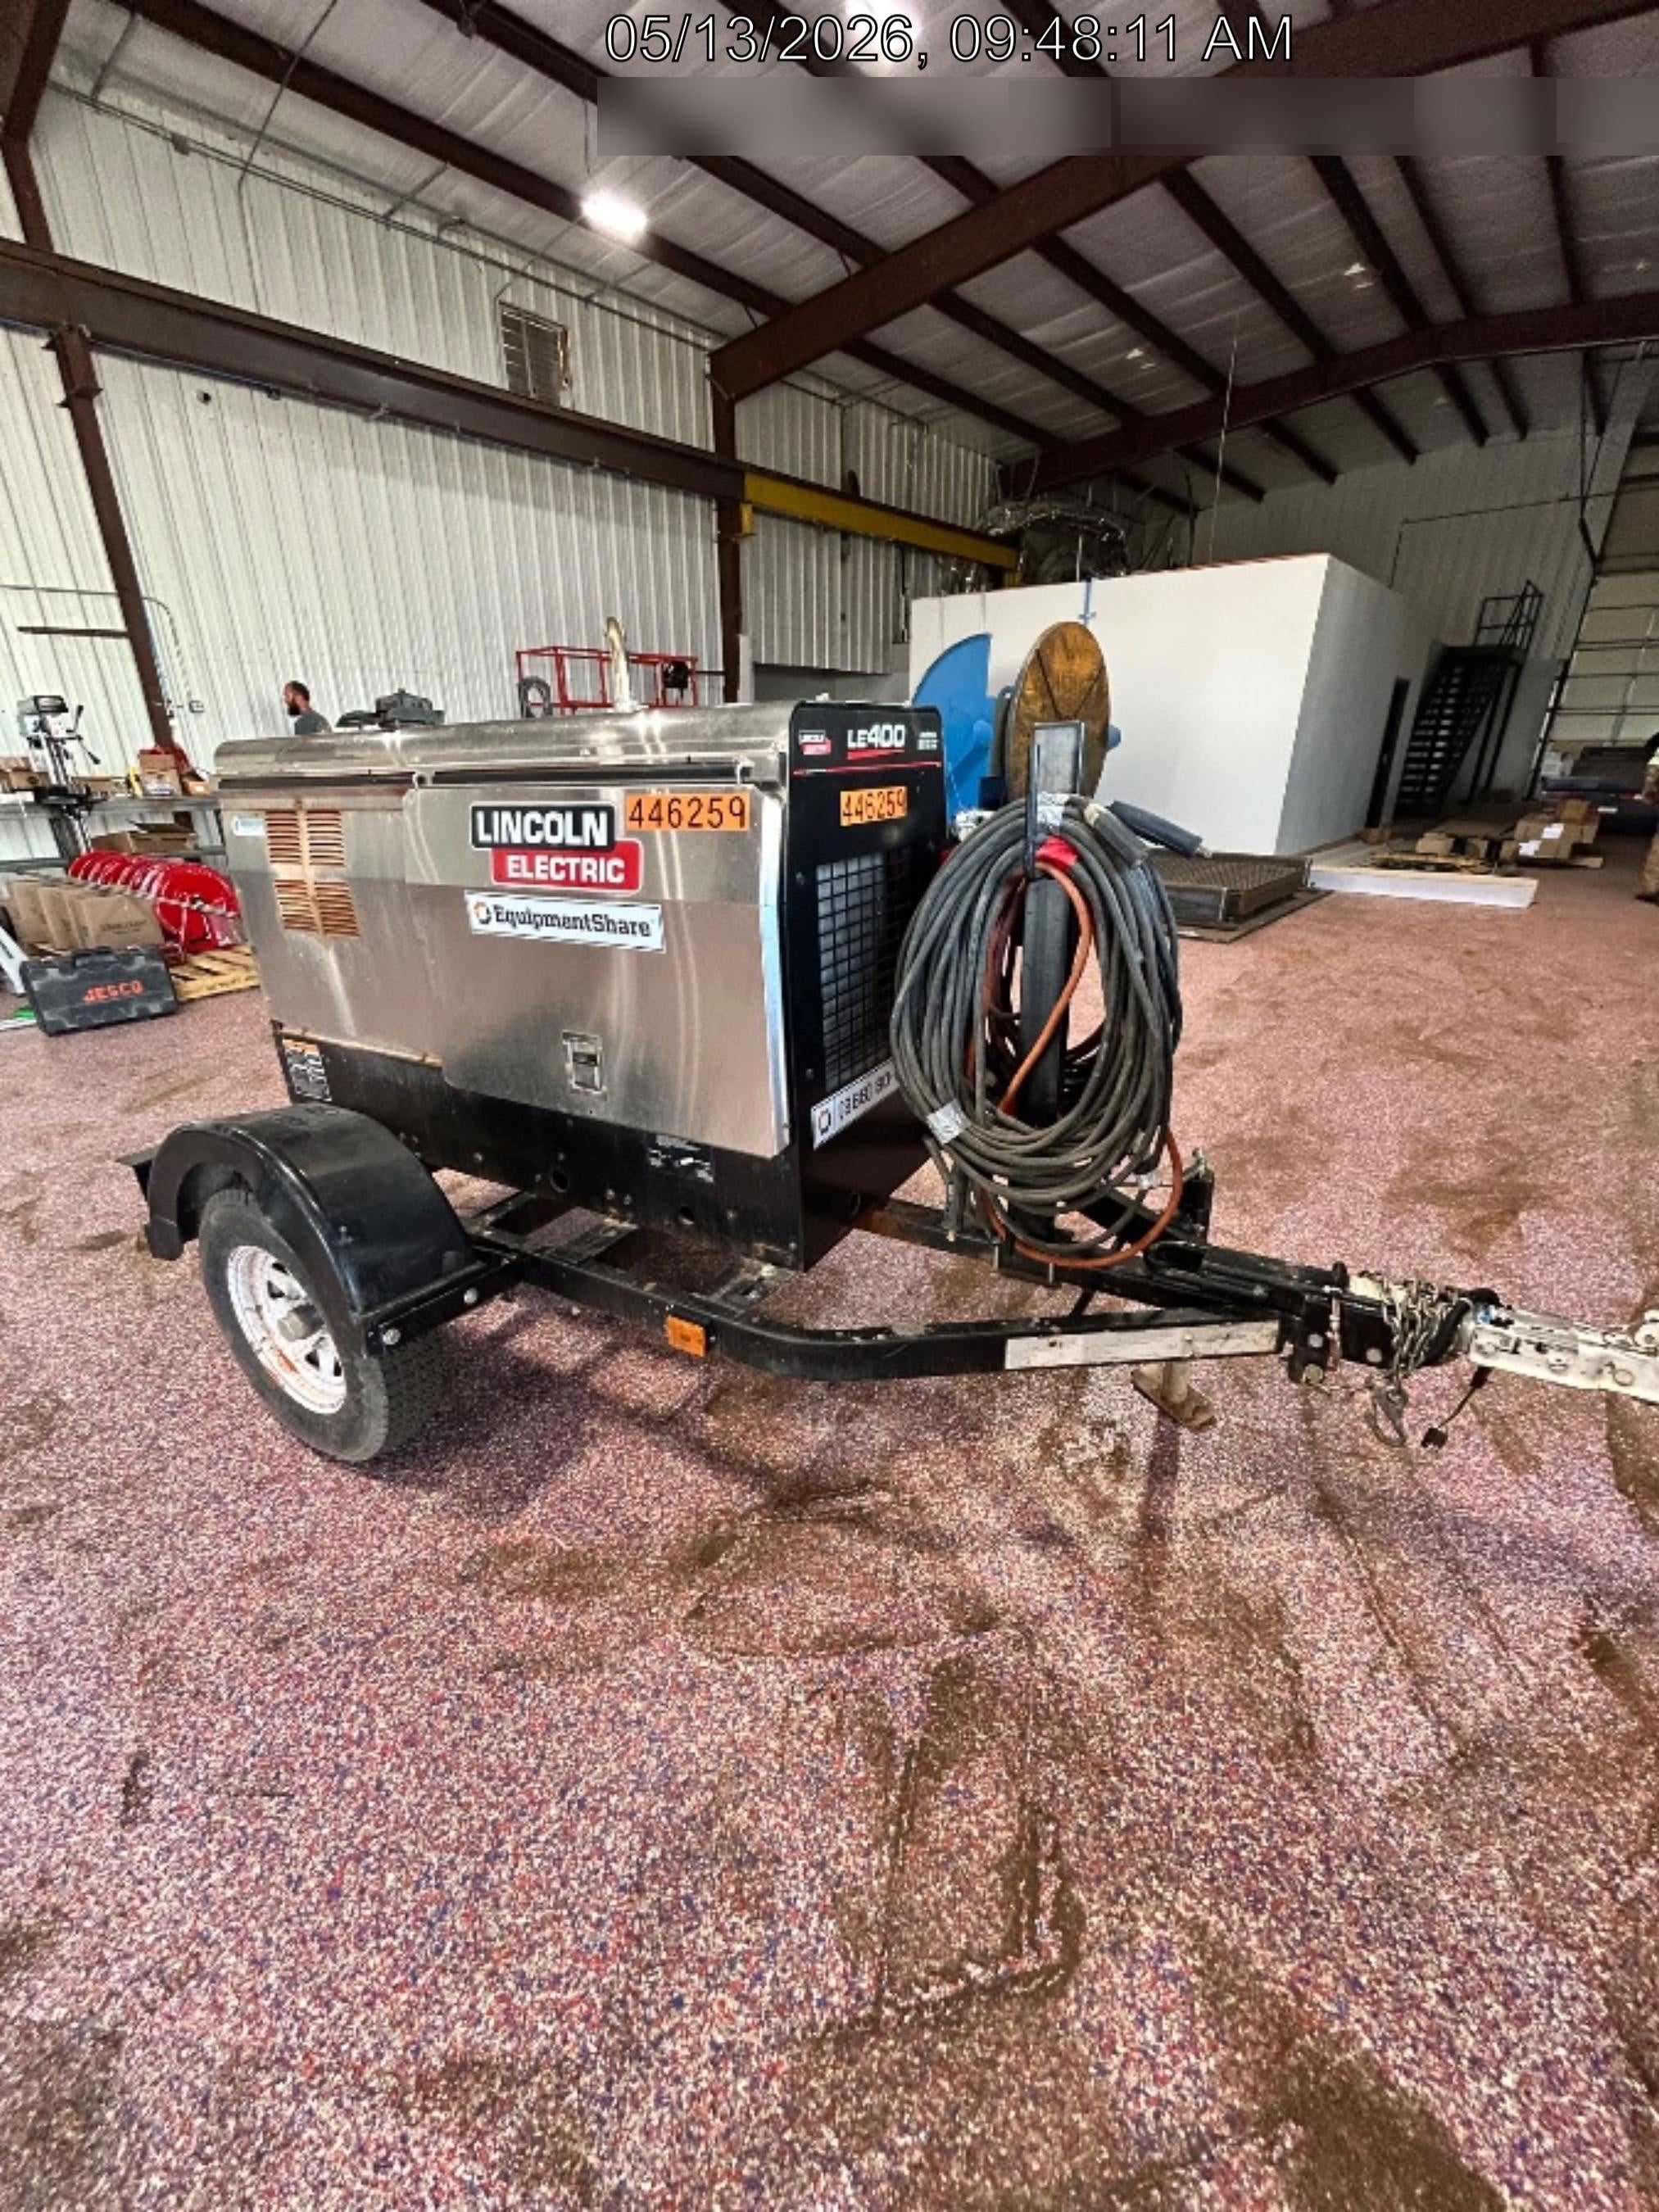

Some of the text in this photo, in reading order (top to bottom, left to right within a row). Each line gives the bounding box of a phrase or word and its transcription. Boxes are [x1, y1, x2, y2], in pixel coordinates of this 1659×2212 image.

[846, 723, 906, 749] LE400
[475, 809, 609, 847] LINCOLN
[628, 796, 746, 830] 446259
[505, 854, 625, 884] ELECTRIC
[492, 904, 652, 938] EquipmentShare
